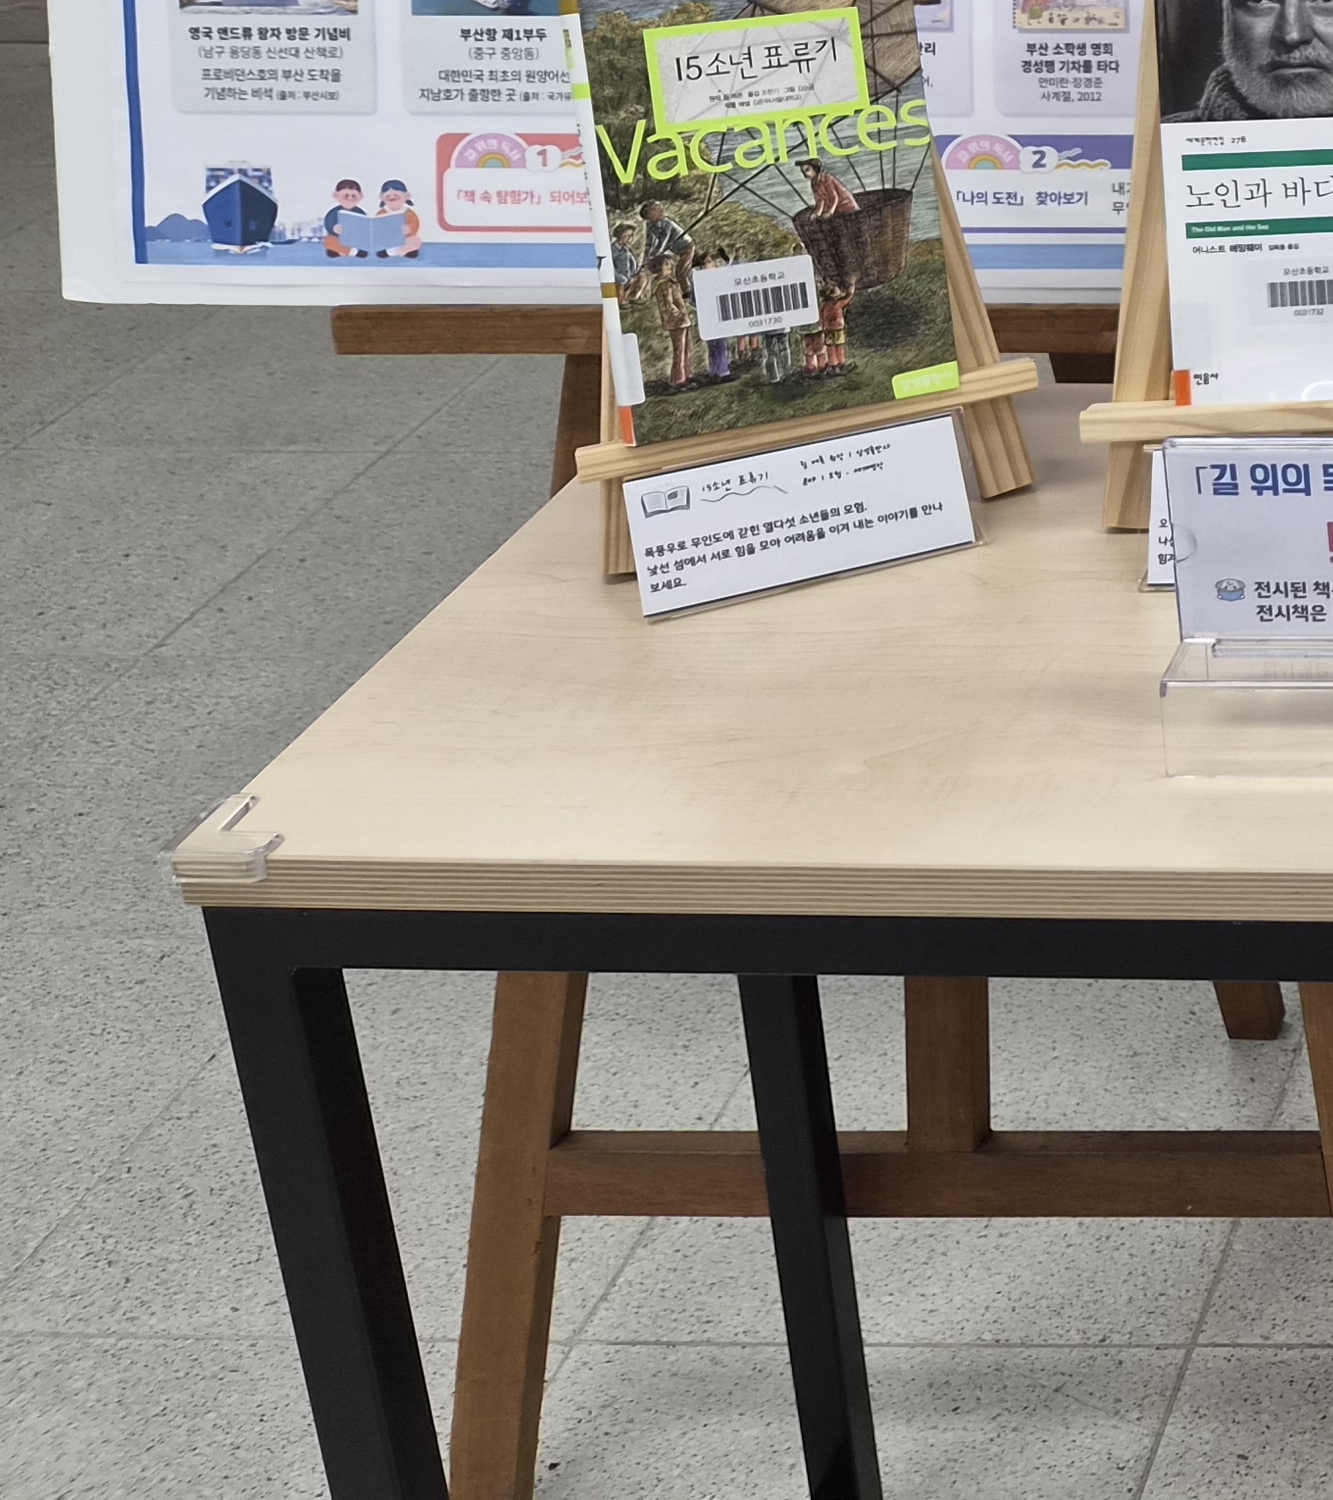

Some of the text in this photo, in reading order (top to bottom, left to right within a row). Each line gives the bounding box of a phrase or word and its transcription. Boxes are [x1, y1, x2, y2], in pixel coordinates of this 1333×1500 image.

[675, 36, 838, 82] 15소년 표류기
[1026, 42, 1113, 56] 부산 소학생 영희
[595, 100, 931, 184] Vacances
[956, 191, 1088, 206] 「나의 도전」 찾아보기
[1185, 178, 1272, 209] 노인과
[1195, 463, 1238, 497] 「길
[1250, 463, 1310, 495] 위의
[1253, 581, 1307, 599] 전시된
[1256, 604, 1327, 623] 전시책은
